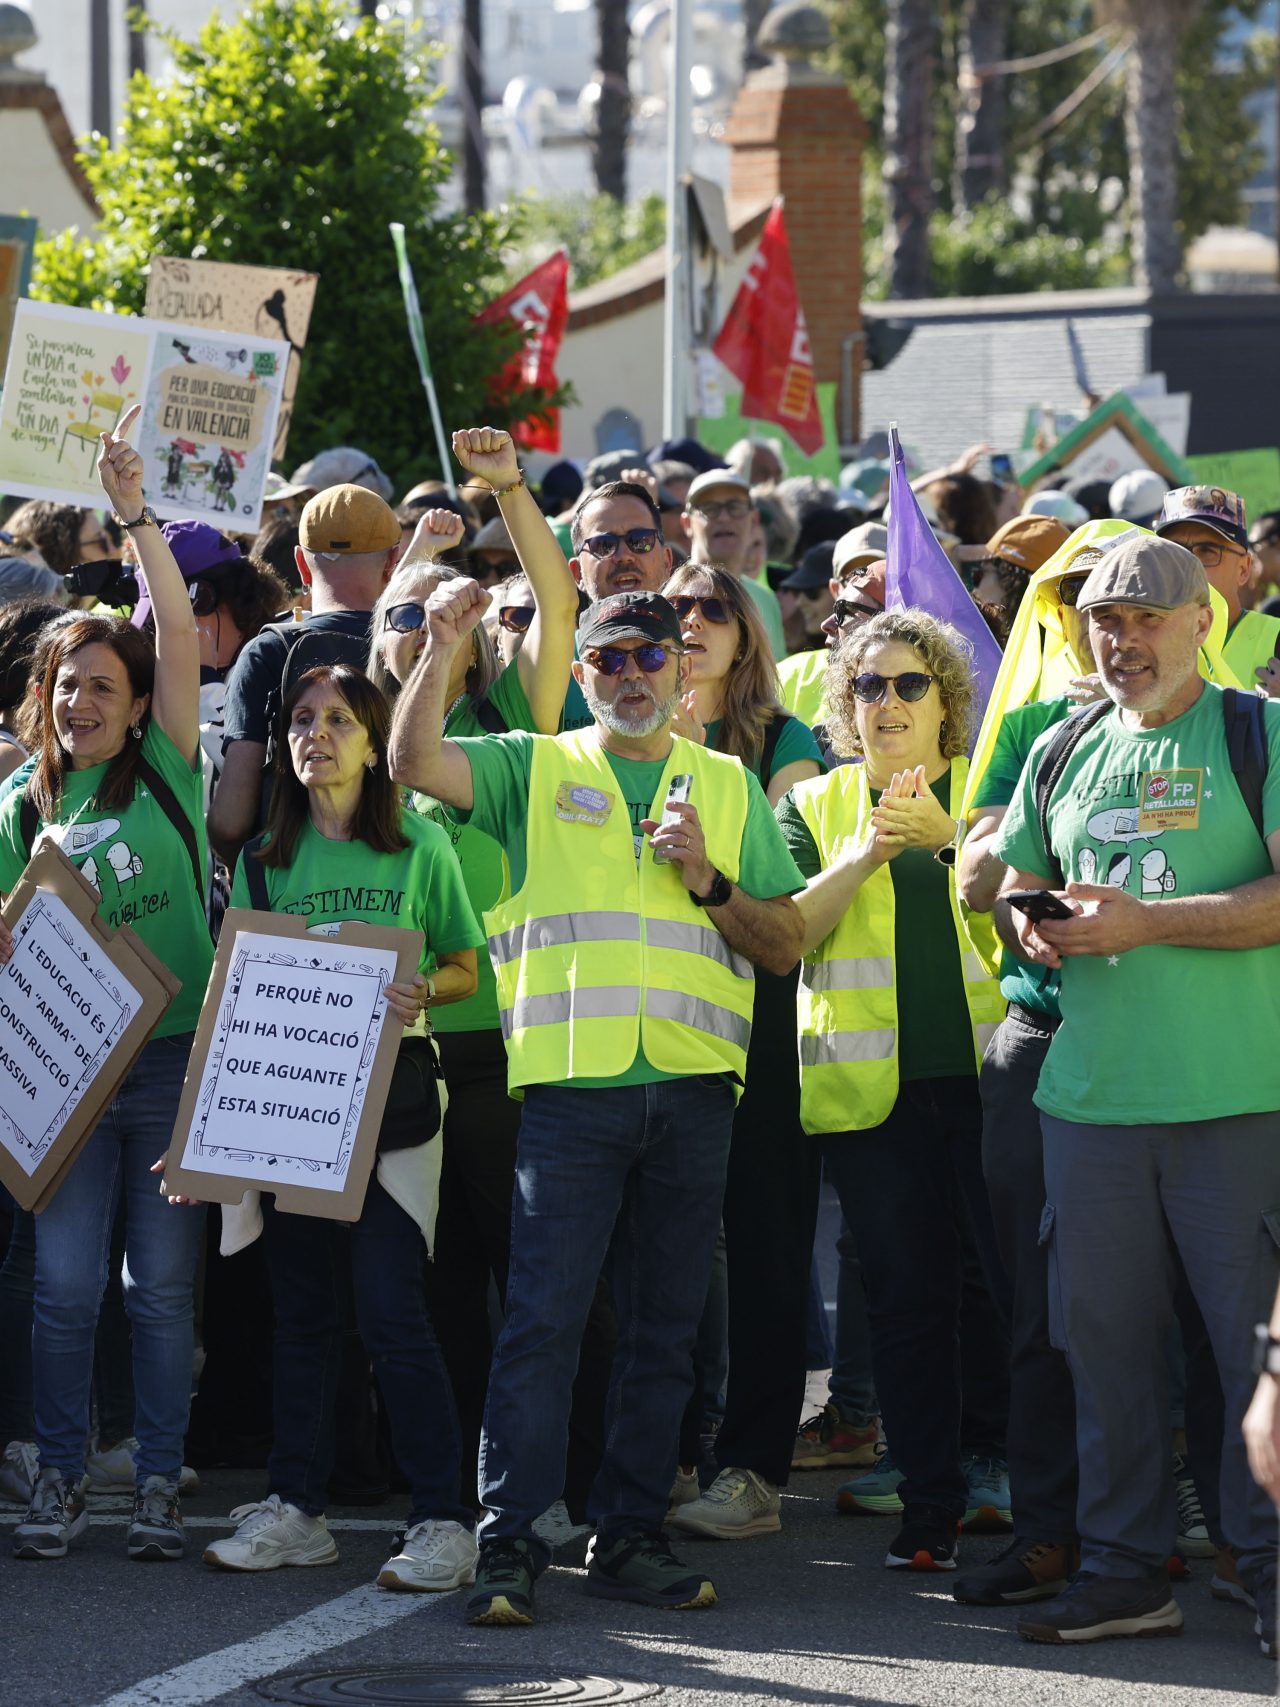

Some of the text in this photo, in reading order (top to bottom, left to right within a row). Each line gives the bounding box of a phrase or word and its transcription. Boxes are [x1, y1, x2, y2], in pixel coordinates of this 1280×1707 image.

[27, 351, 41, 367] UN
[169, 375, 189, 393] PER
[210, 381, 257, 404] EDUCACIÓ
[20, 413, 35, 429] UN
[163, 405, 251, 440] EN VALENCIÀ
[1148, 779, 1194, 797] STOP FP
[1142, 812, 1151, 820] JA
[1143, 799, 1196, 810] RETALLADES
[282, 886, 405, 917] ESTIMEM
[28, 939, 106, 1034] L'EDUCACIÓ ÉS
[255, 983, 353, 1009] PERQUÈ NO
[8, 963, 34, 999] UNA
[74, 1043, 92, 1067] DE
[232, 1018, 359, 1049] HI HA VOCACIÓ
[226, 1057, 348, 1087] QUE AGUANTE
[218, 1096, 341, 1126] ESTA SITUACIÓ
